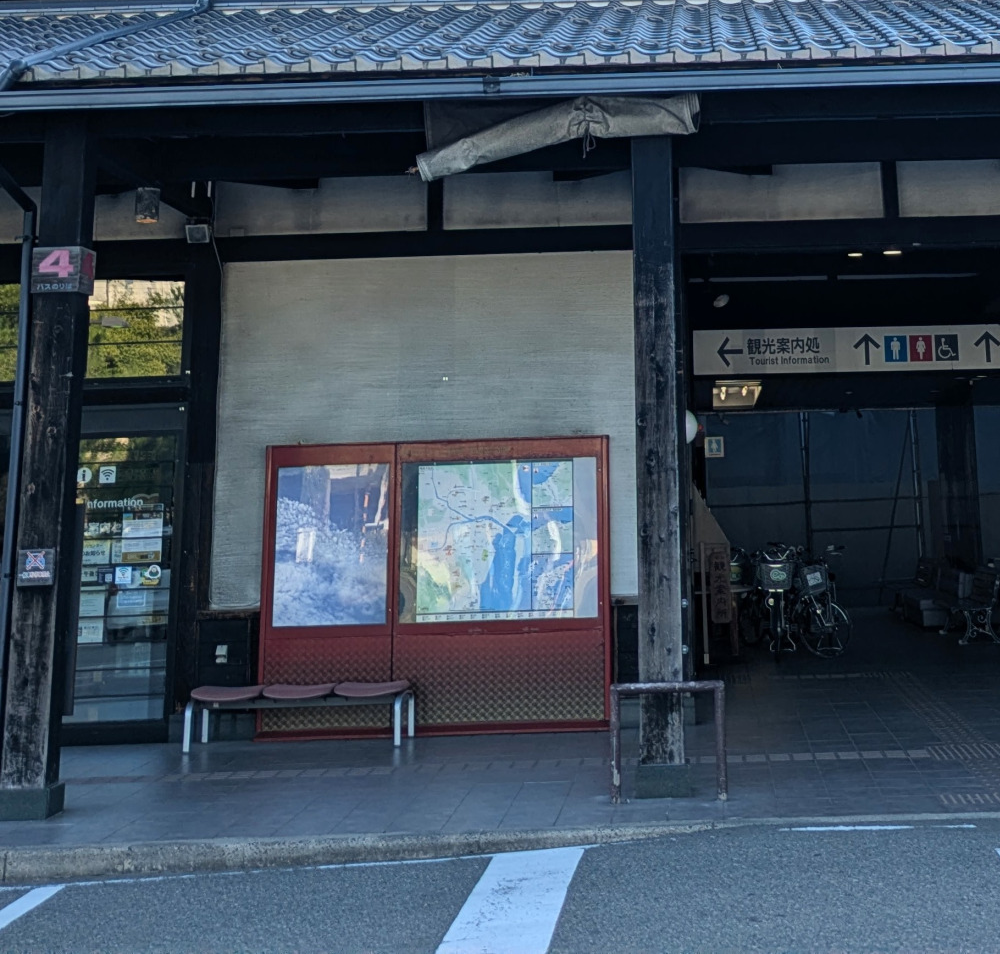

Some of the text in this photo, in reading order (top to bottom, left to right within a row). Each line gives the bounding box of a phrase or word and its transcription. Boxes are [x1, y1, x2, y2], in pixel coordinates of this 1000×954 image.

[38, 249, 74, 278] 4
[747, 337, 820, 355] 観光案内処
[749, 355, 830, 366] Tourist Information
[86, 498, 144, 509] nformation
